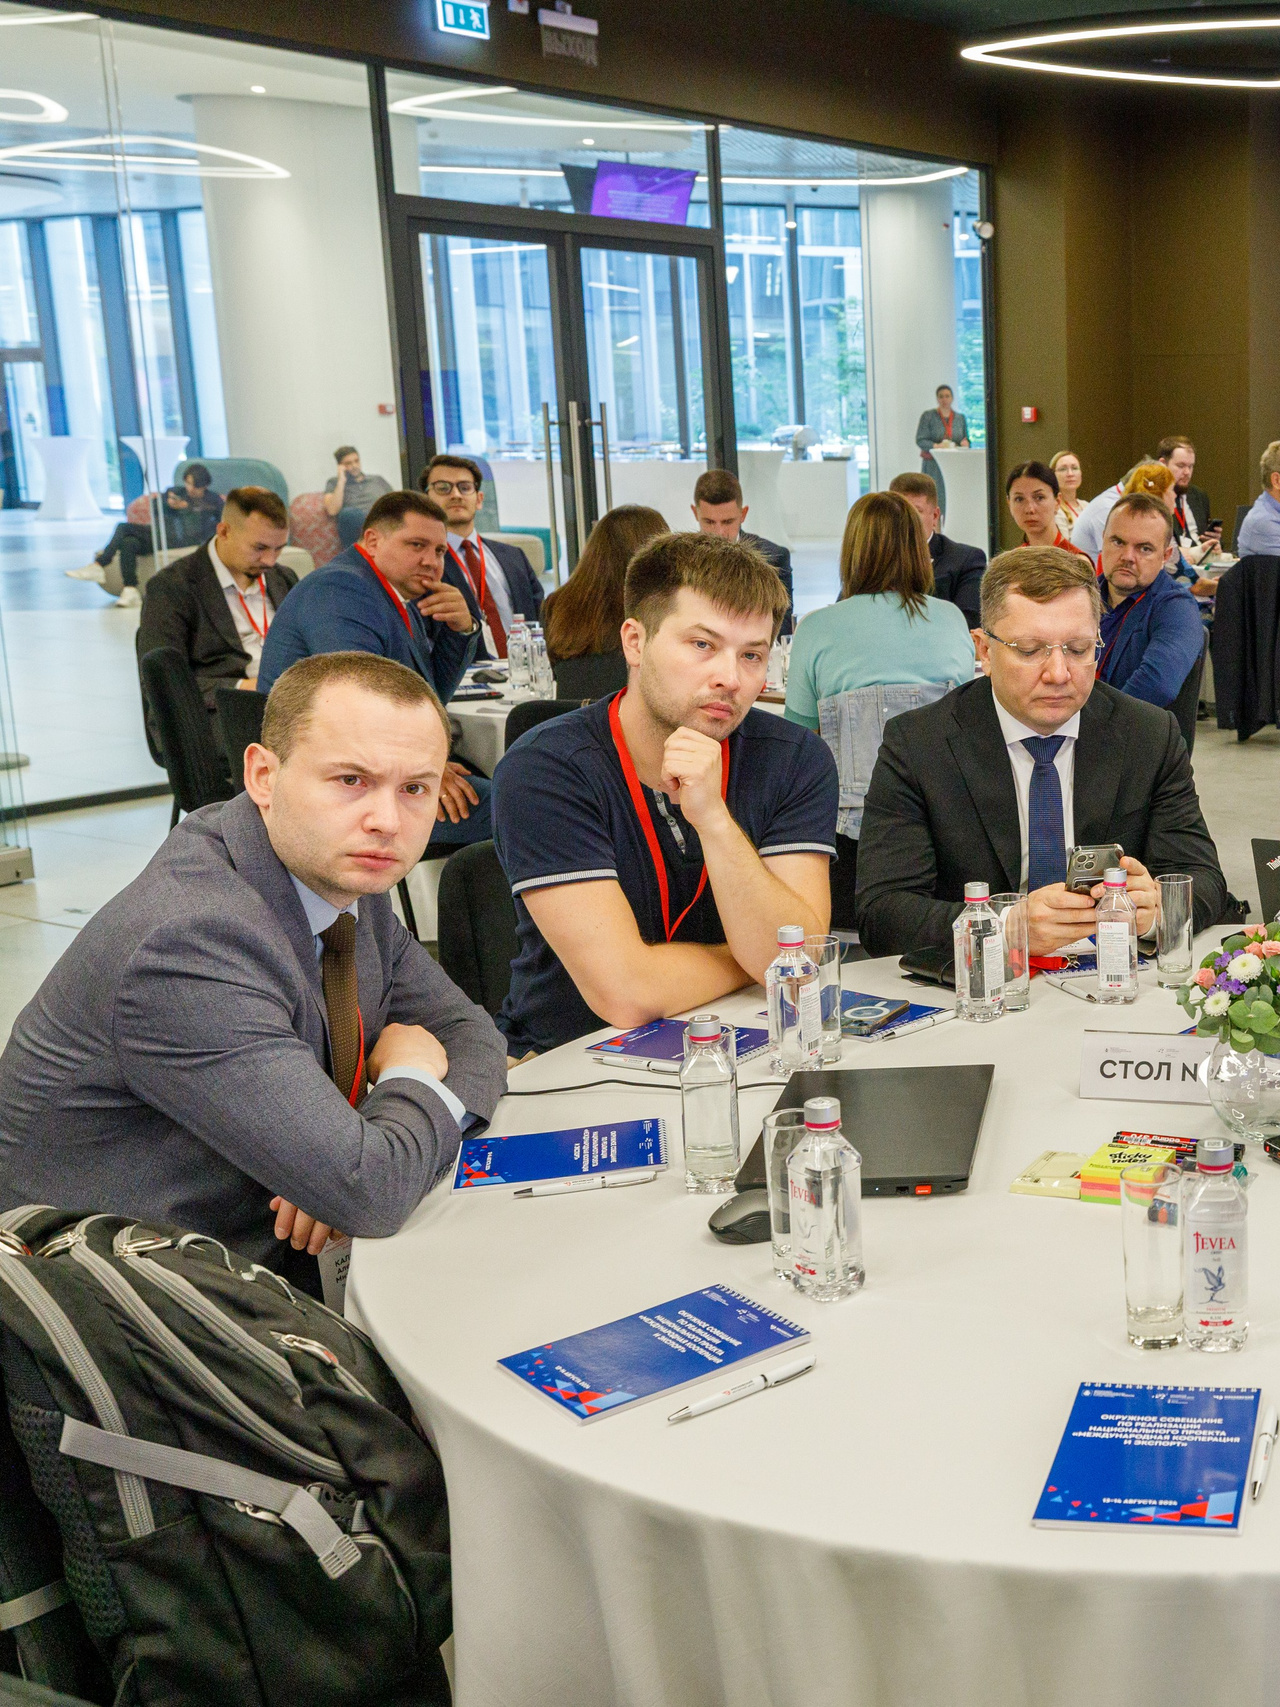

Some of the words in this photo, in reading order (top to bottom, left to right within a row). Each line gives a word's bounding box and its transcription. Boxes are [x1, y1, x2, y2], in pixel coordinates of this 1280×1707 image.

[1100, 1059, 1172, 1081] СТОЛ
[1109, 1151, 1153, 1159] sticky
[1193, 1231, 1236, 1254] JEVEA
[1100, 1413, 1158, 1422] ОКРУЖНОЕ
[1160, 1416, 1224, 1425] СОВЕЩАНИЕ
[1089, 1426, 1180, 1435] НАЦИОНАЛЬНОГО
[1181, 1429, 1227, 1437] ПРОЕКТА
[1134, 1422, 1201, 1430] РЕАЛИЗАЦИИ
[1072, 1431, 1171, 1441] «МЕЖДУНАРОДНАЯ
[1172, 1435, 1241, 1444] КООПЕРАЦИЯ
